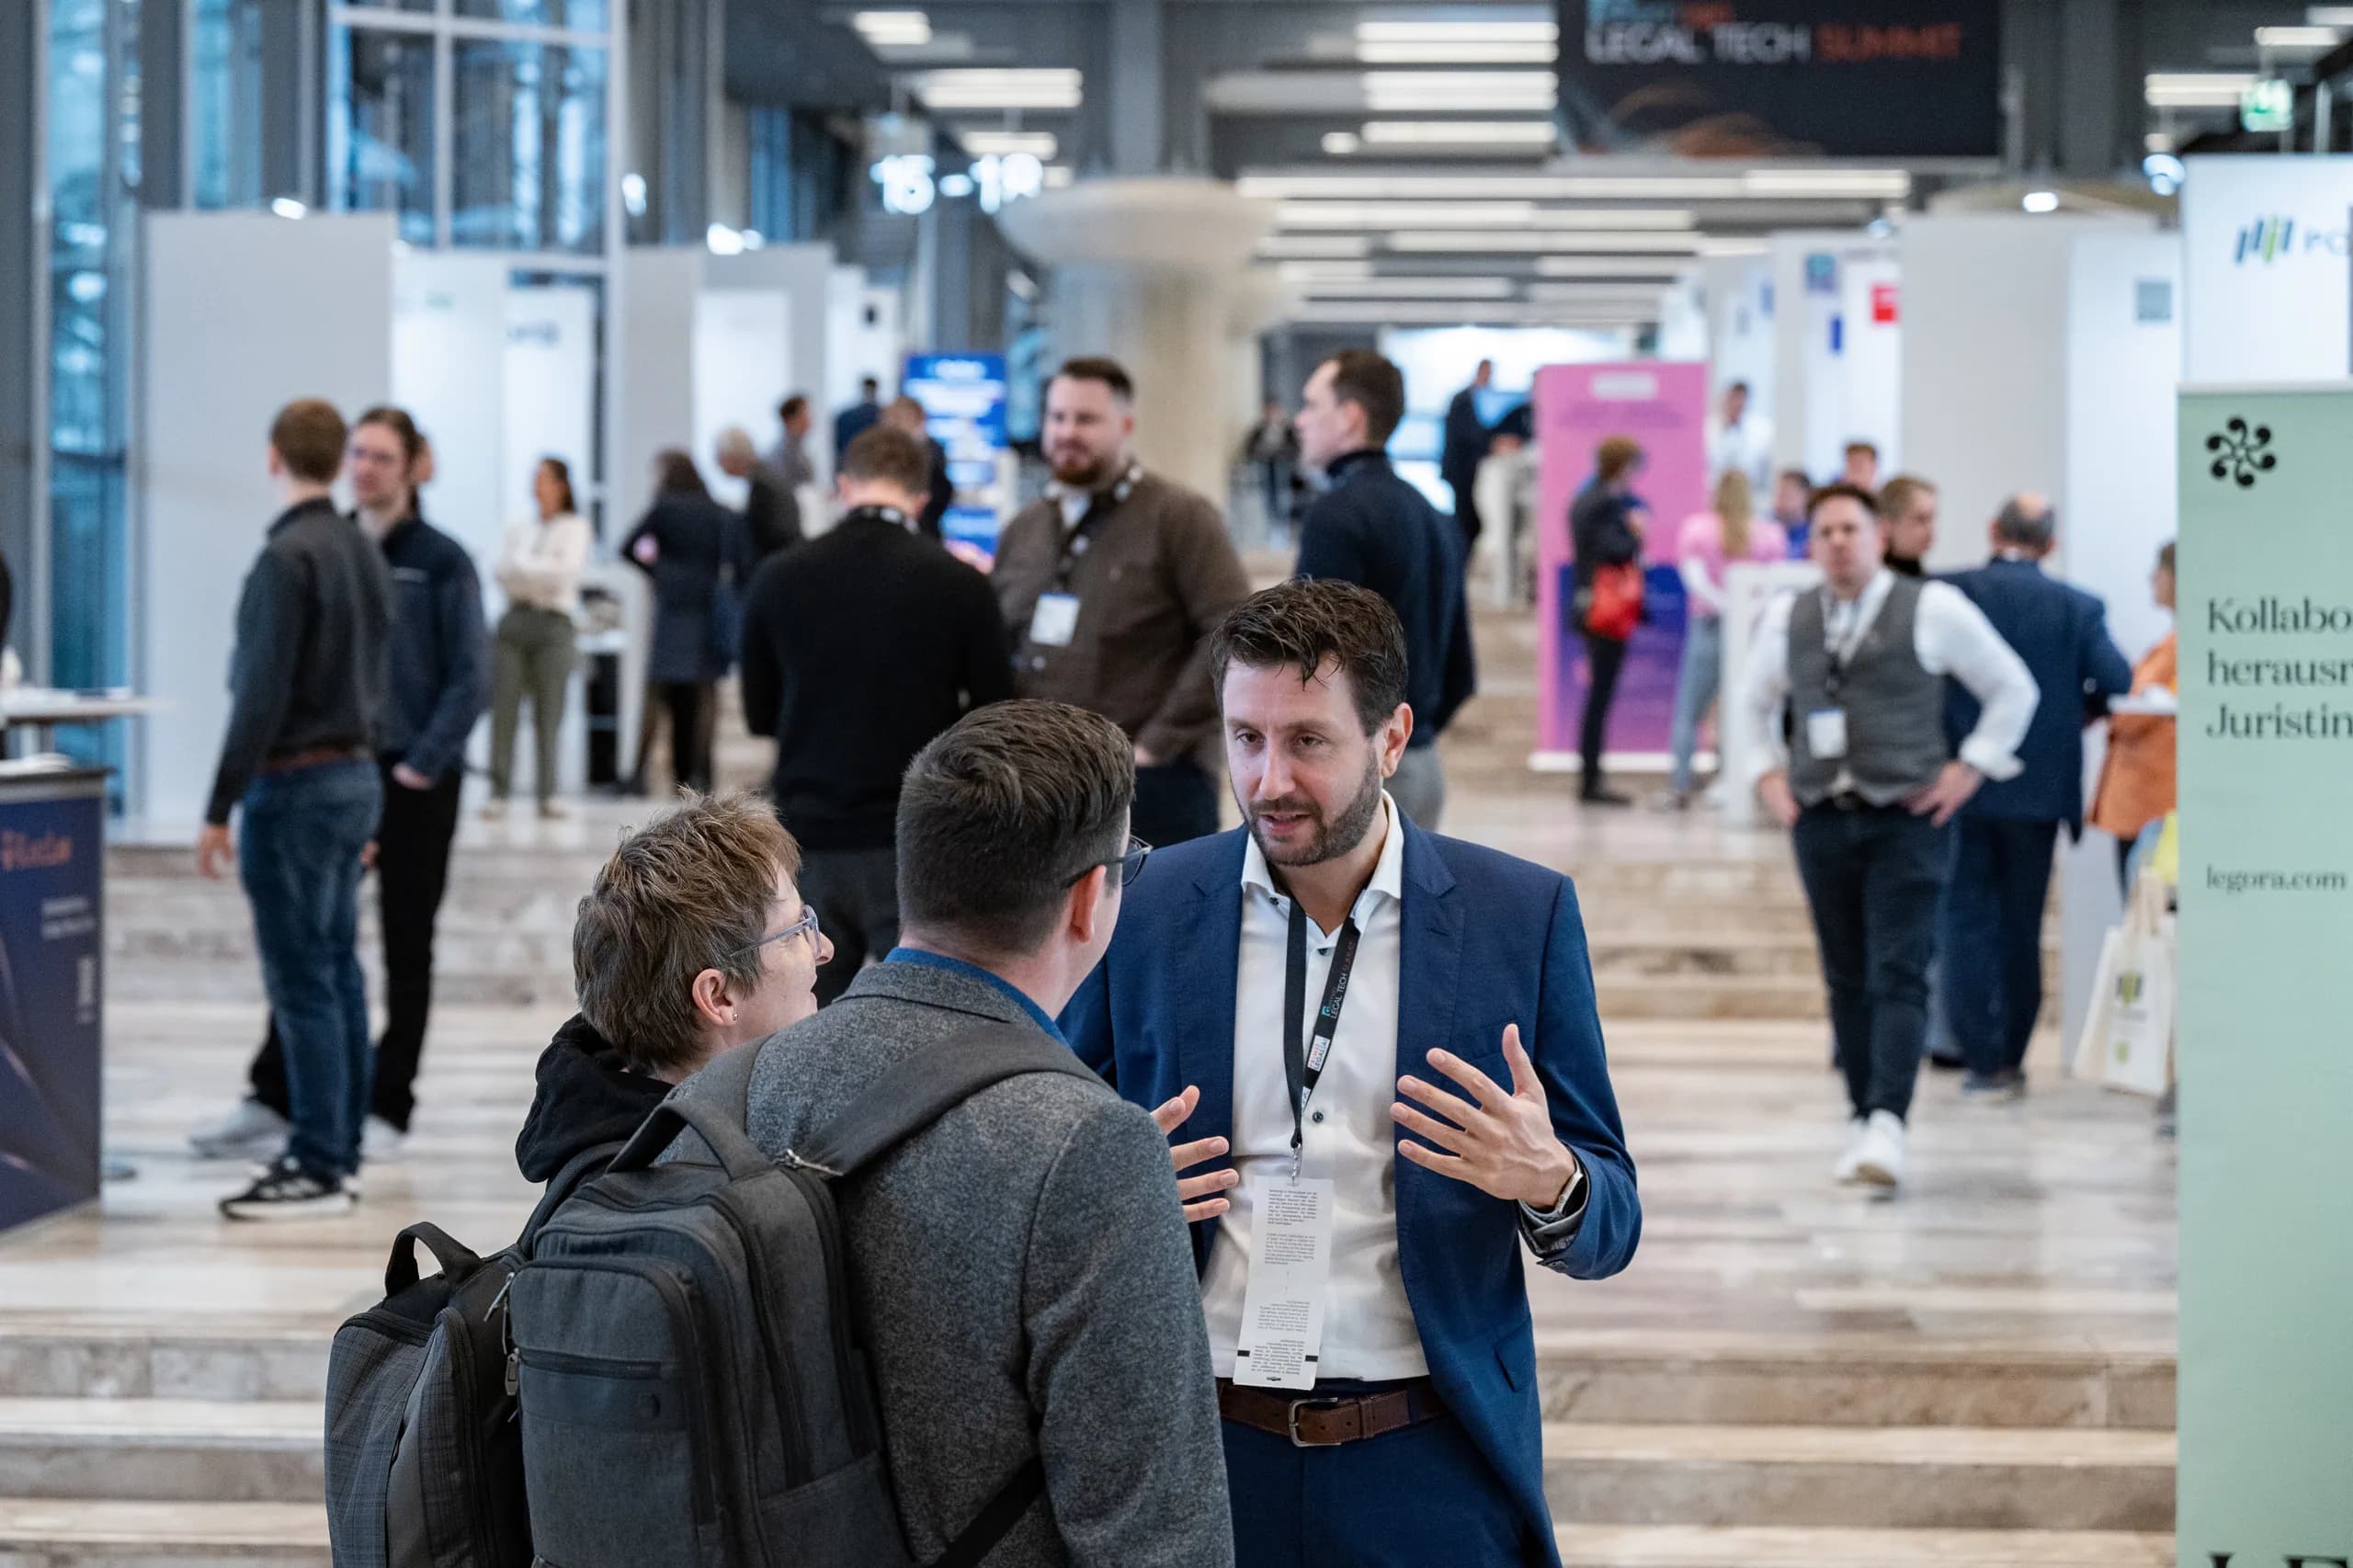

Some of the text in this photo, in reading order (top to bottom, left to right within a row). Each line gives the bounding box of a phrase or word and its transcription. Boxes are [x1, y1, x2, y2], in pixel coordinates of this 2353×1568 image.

[1585, 21, 1962, 64] LEGAL TECH SUMMIT
[2208, 597, 2353, 633] Kollabo
[2206, 702, 2353, 737] Juristin
[2207, 864, 2347, 895] legora.com
[1330, 994, 1342, 1019] LEGAL
[1336, 972, 1348, 994] TECH
